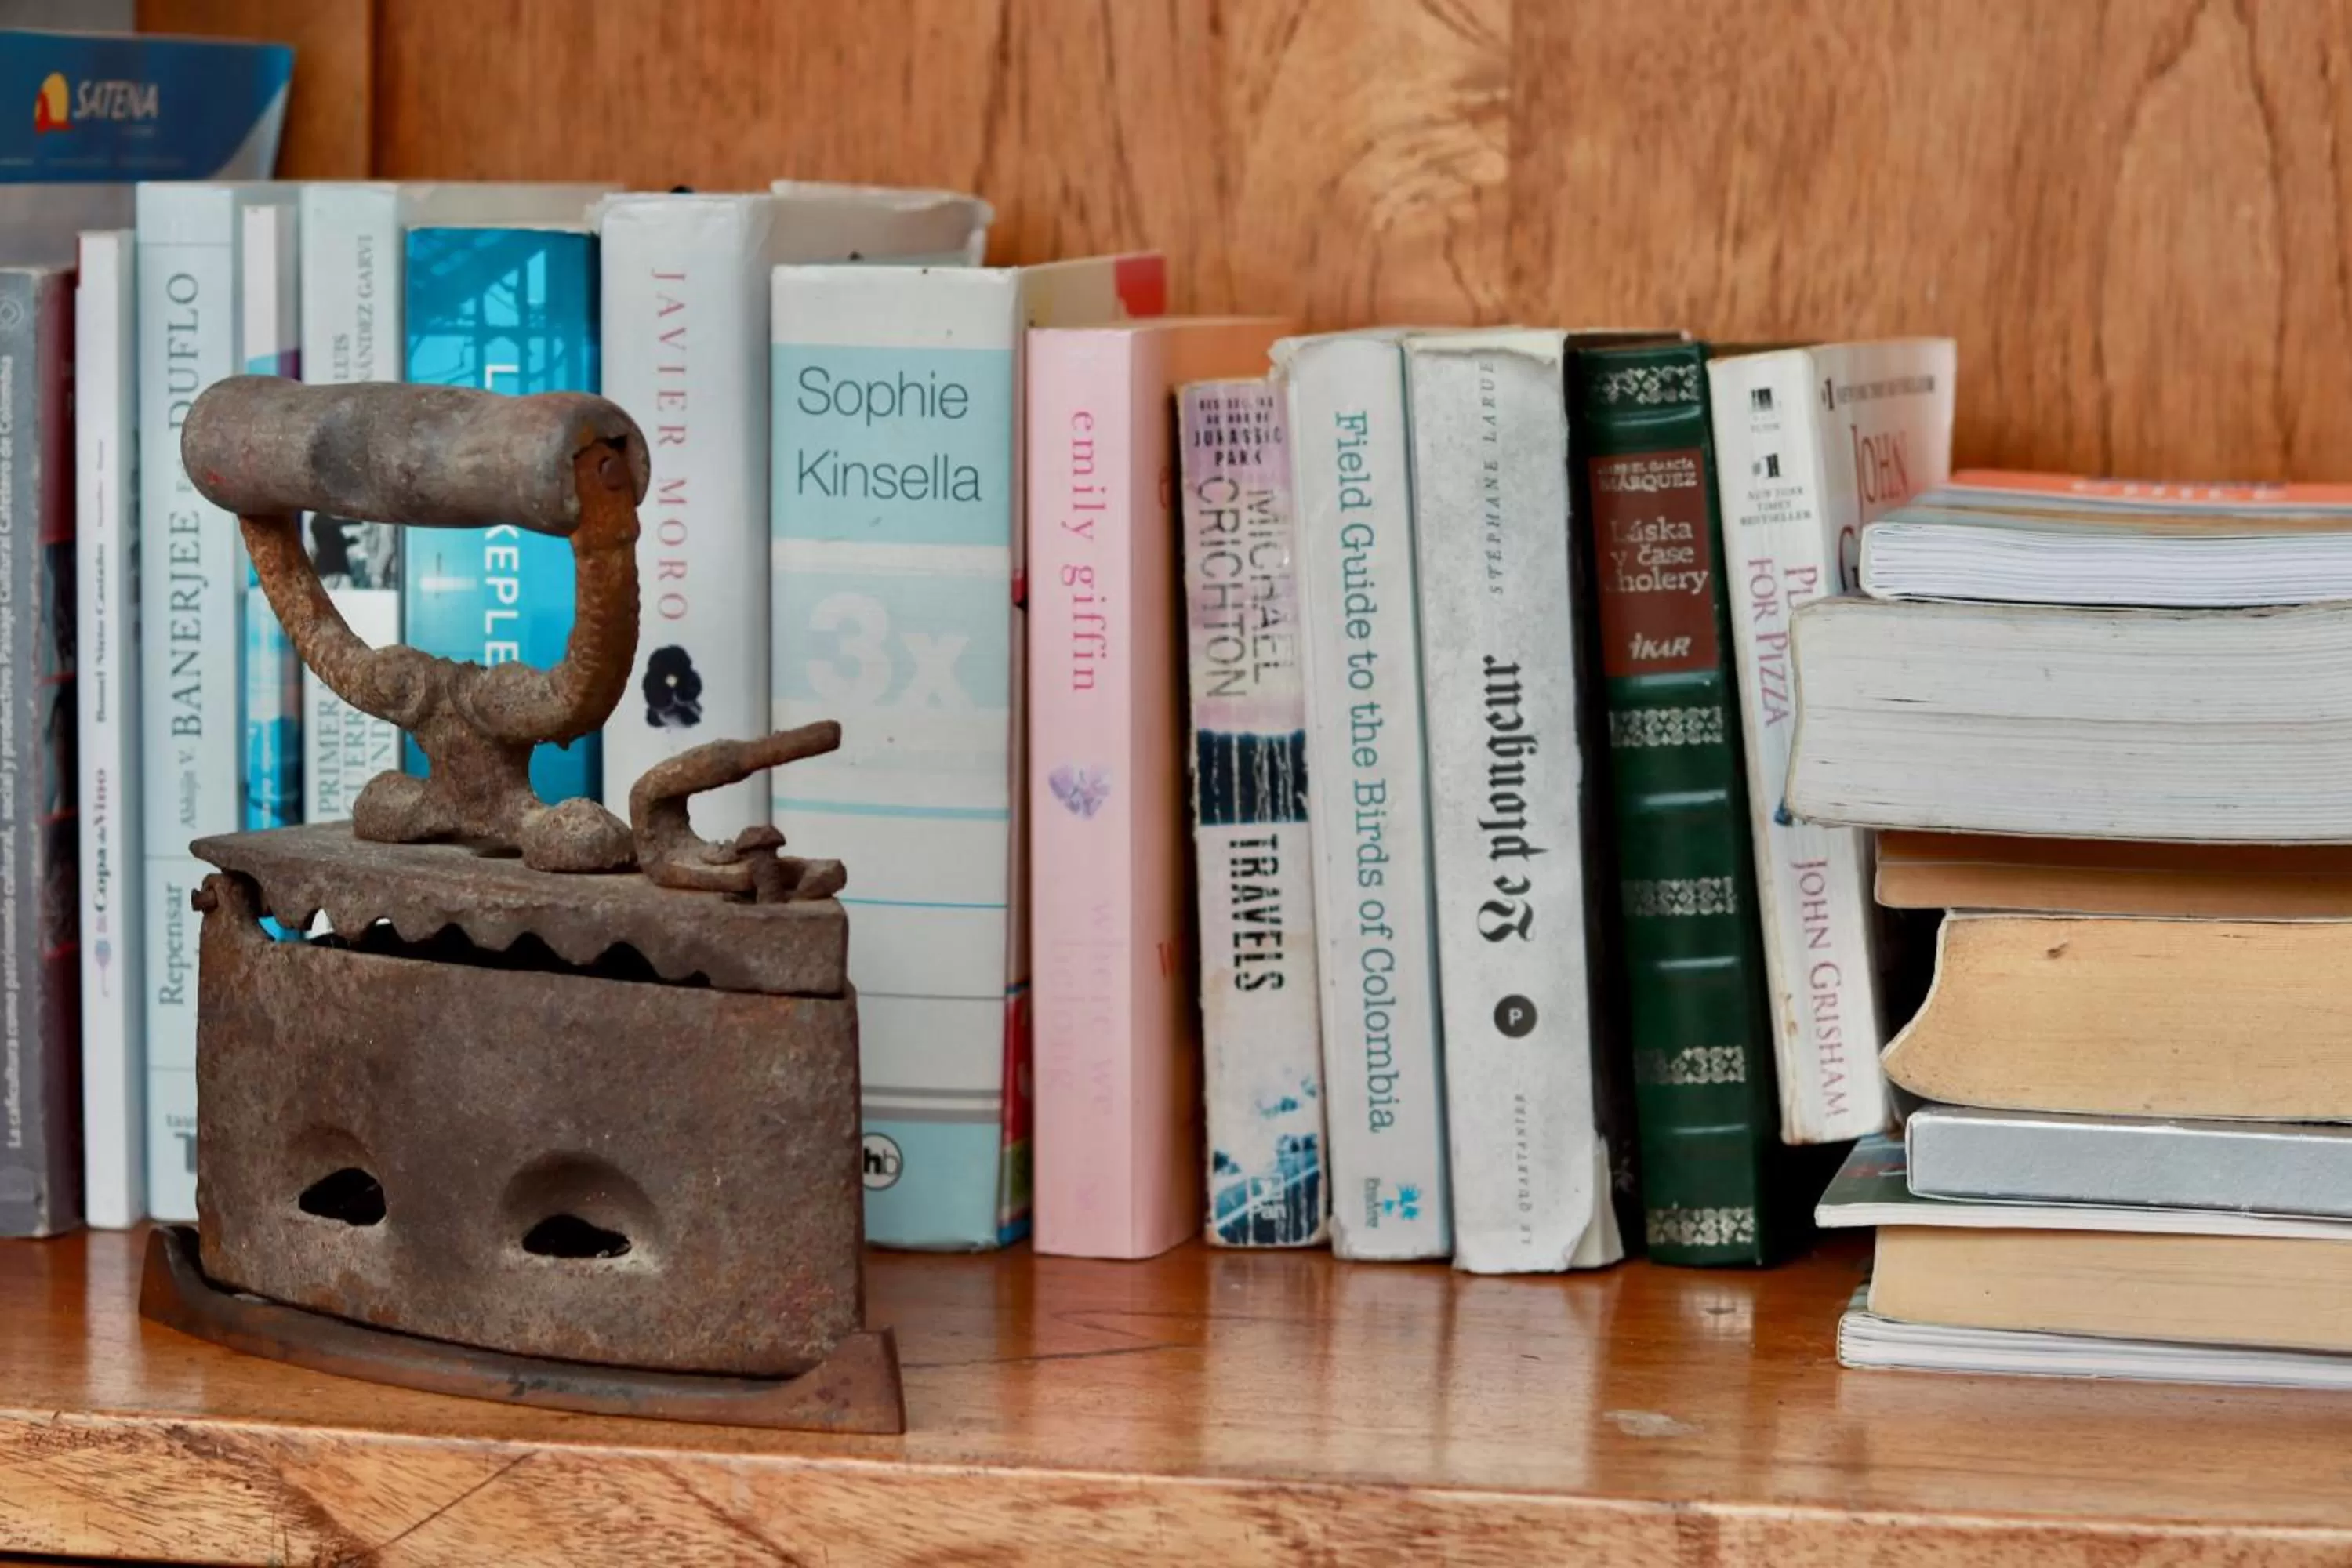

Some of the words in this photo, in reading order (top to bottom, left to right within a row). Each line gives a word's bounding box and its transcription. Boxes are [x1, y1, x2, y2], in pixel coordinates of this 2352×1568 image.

[78, 80, 158, 119] SATENA
[165, 271, 201, 430] DUFLO
[651, 269, 688, 448] JAVIER
[797, 365, 970, 427] Sophie
[1479, 361, 1498, 443] LARUE
[797, 448, 983, 503] Kinsella
[1060, 411, 1107, 540] emily
[1193, 426, 1283, 448] JURASSIC
[1214, 449, 1262, 467] PARK
[1334, 410, 1374, 513] Field
[656, 478, 688, 621] MORO
[1483, 459, 1504, 596] STÉPHANE
[1607, 565, 1709, 596] holery
[1610, 515, 1694, 543] Láska
[1636, 543, 1695, 567] čase
[168, 510, 208, 738] BANERJEE
[485, 524, 519, 667] KEPLE
[1060, 564, 1108, 692] giffin
[1197, 476, 1247, 699] CRICHTON
[1247, 488, 1296, 684] MICHAEL
[1341, 522, 1377, 641] Guide
[1748, 558, 1780, 623] FOR
[805, 591, 975, 708] 3x
[1348, 652, 1378, 691] to
[1755, 631, 1791, 729] PIZZA
[316, 684, 340, 815] PRIMER
[1350, 702, 1384, 768] the
[1477, 653, 1550, 862] plongeur
[94, 847, 111, 913] Copa
[1353, 779, 1390, 888] Birds
[158, 883, 192, 1005] Repensar
[1229, 833, 1287, 993] TRAVELS
[1359, 899, 1393, 940] of
[1477, 873, 1534, 943] Le
[1790, 859, 1830, 952] JOHN
[1361, 947, 1399, 1134] Colombia
[1807, 960, 1850, 1120] GRISHAM
[7, 1128, 22, 1148] La
